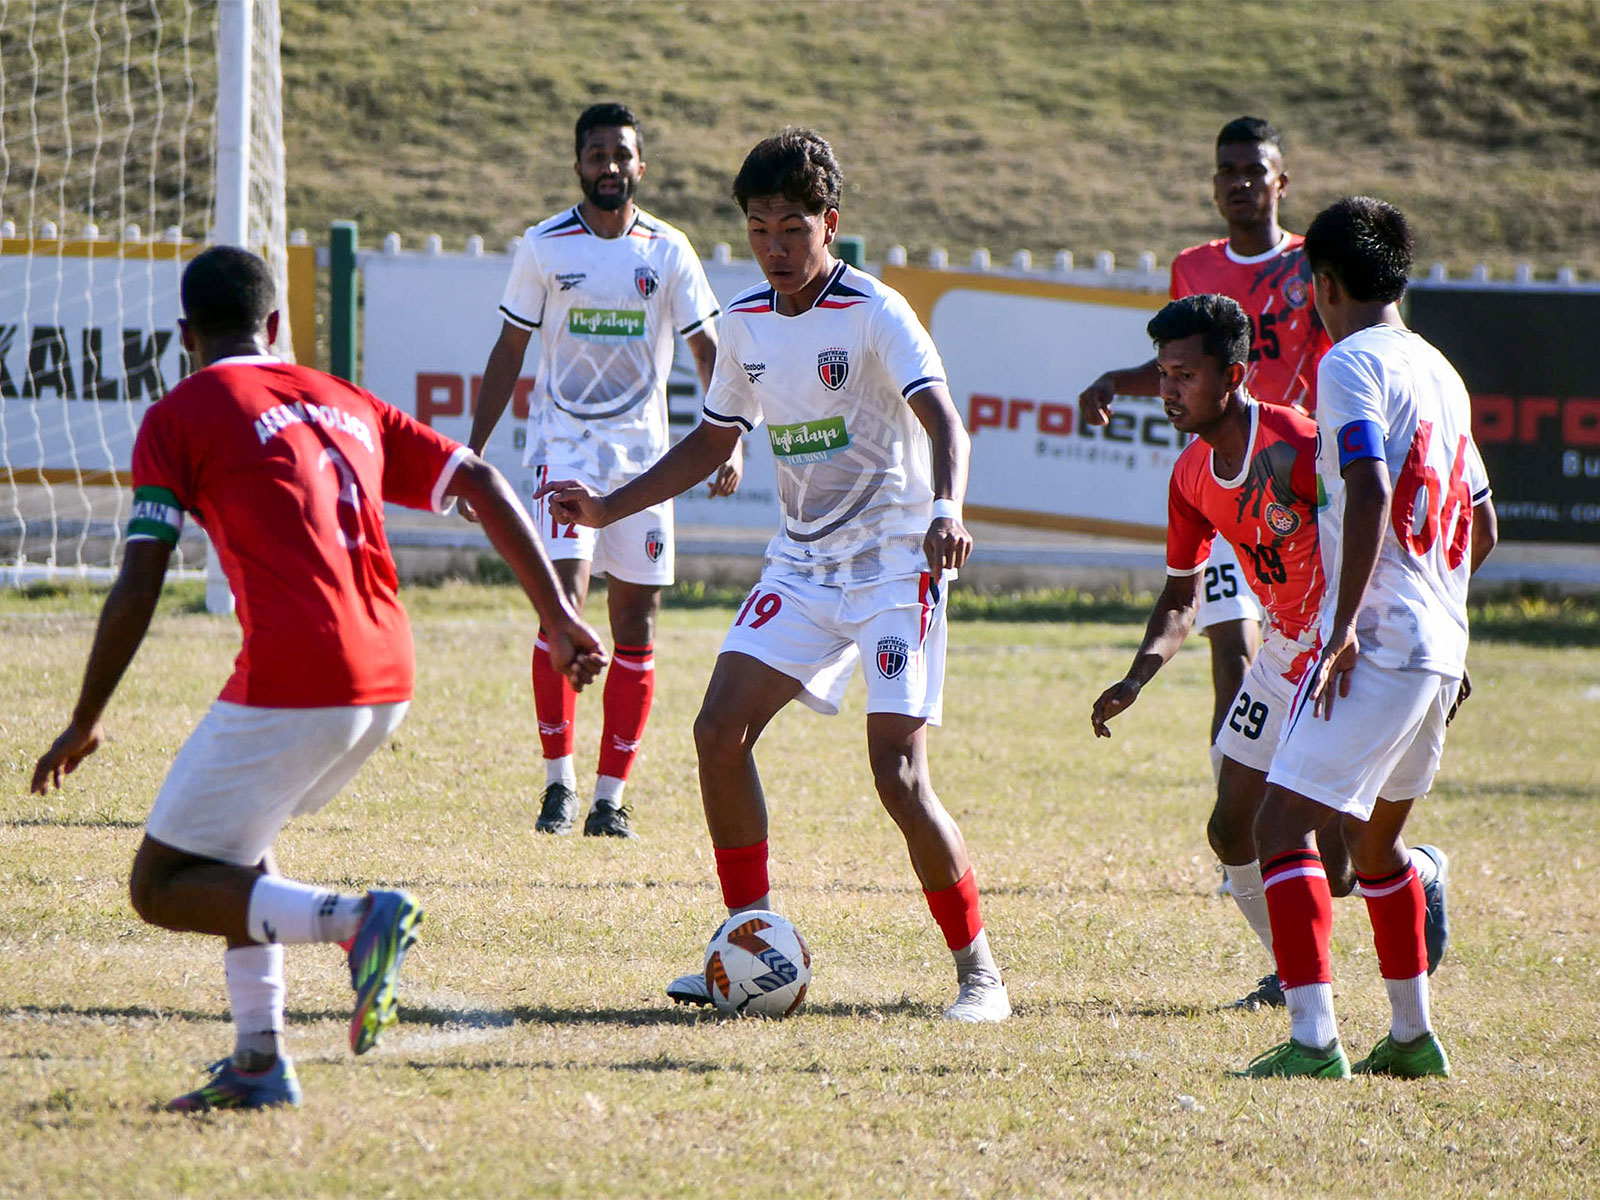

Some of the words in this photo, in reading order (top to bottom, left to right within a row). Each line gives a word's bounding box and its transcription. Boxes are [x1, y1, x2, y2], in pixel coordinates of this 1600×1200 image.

[0, 324, 194, 401] ALK
[743, 362, 766, 371] Reebok
[769, 425, 839, 453] Meghalaya
[969, 393, 1190, 449] protec
[1342, 426, 1363, 453] C
[787, 451, 828, 464] TOURISM
[136, 500, 168, 521] AIN
[1205, 563, 1238, 603] 25
[1239, 543, 1287, 584] 29
[734, 590, 783, 630] 19
[1229, 691, 1269, 740] 29
